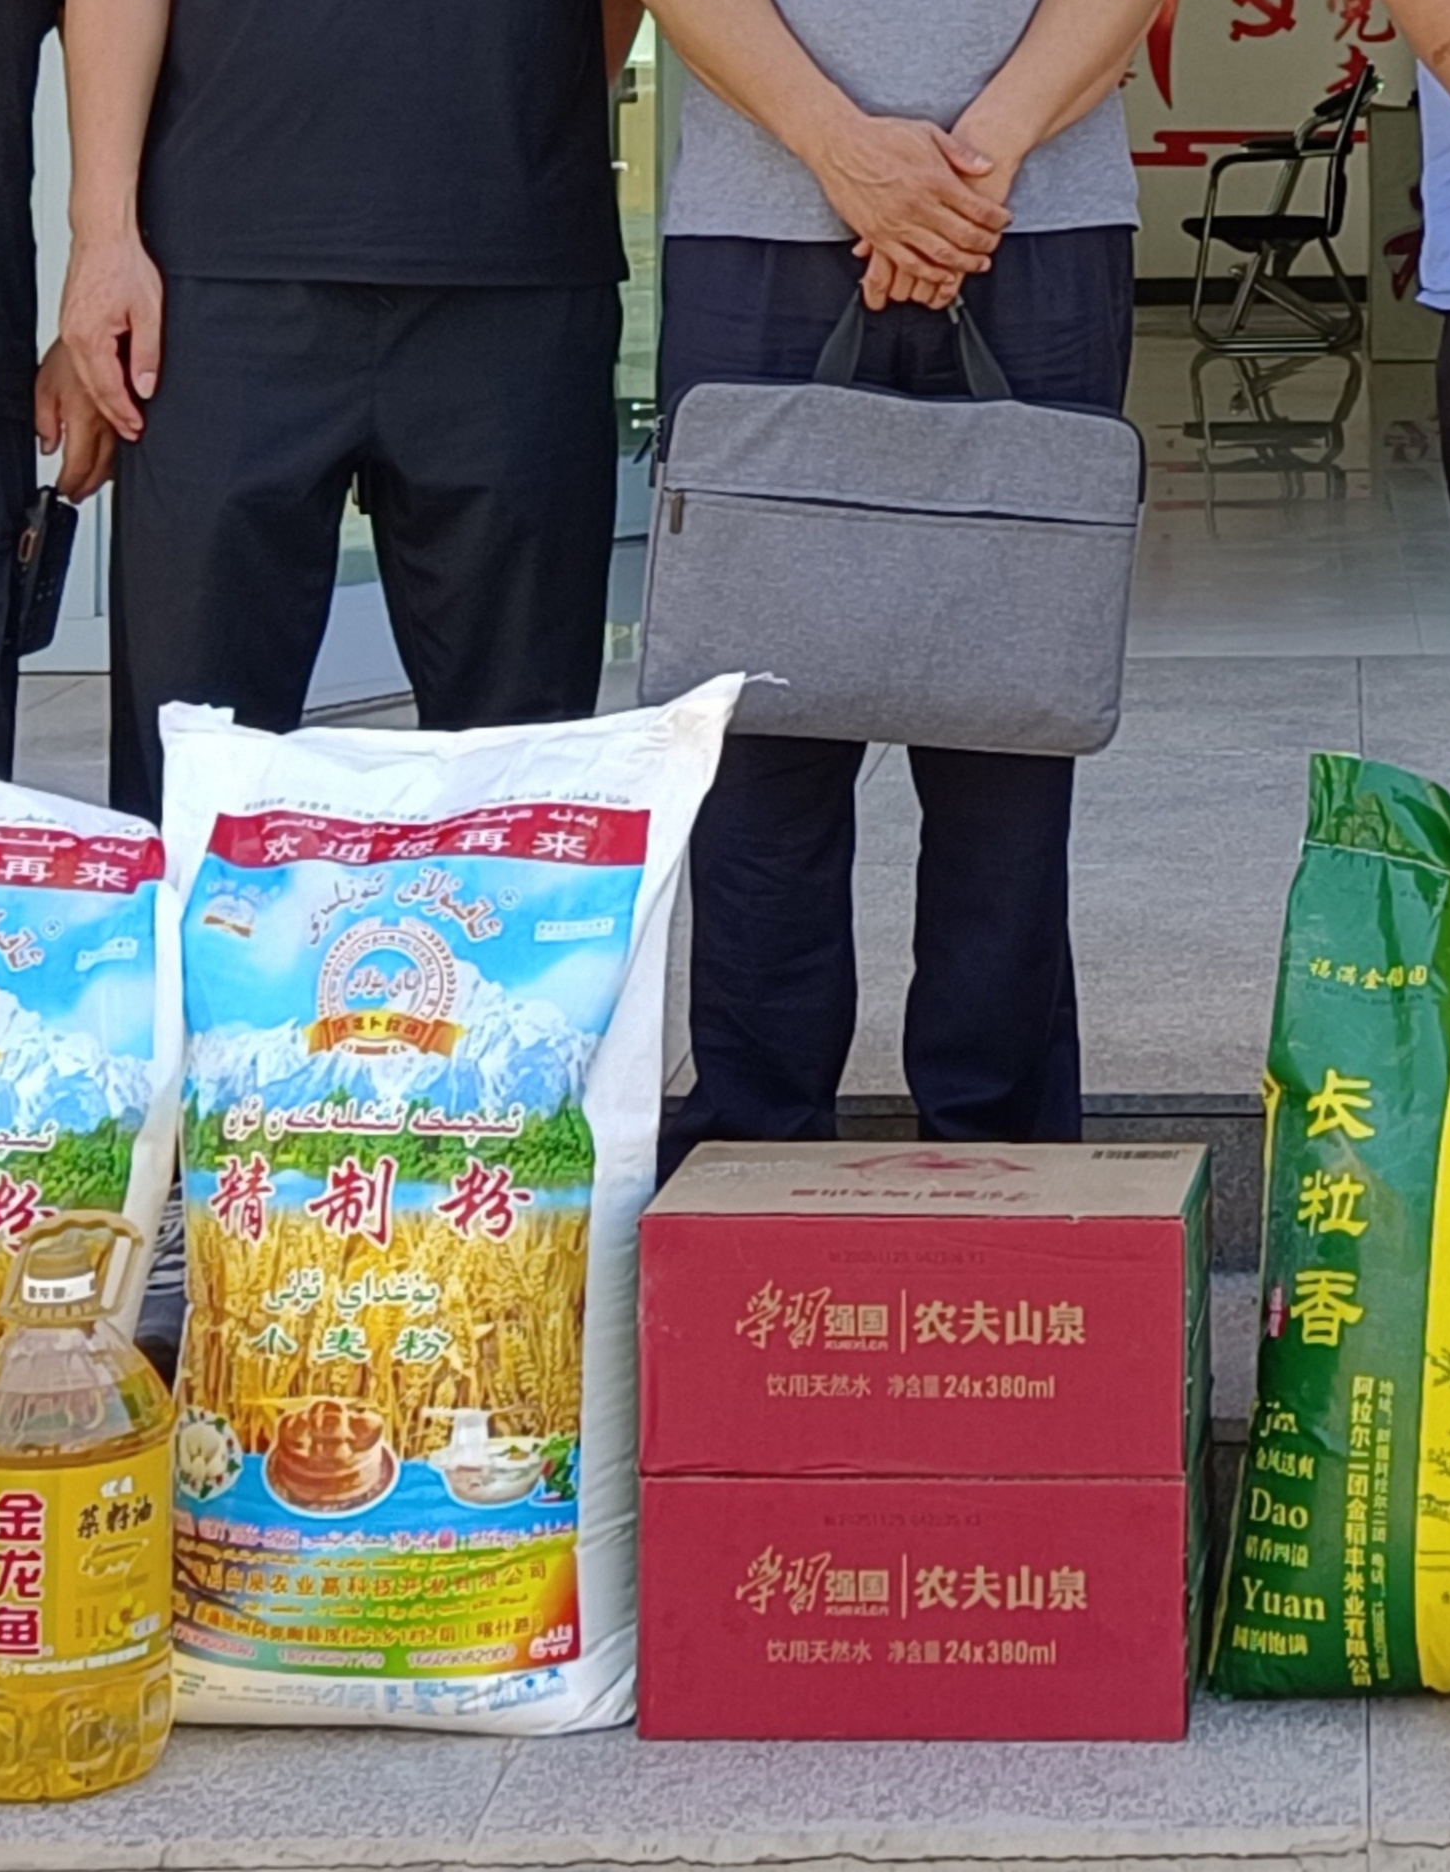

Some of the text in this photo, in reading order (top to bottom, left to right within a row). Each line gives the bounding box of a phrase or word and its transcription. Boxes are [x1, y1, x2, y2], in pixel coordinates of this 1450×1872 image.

[262, 827, 589, 864] 欢迎您再来
[210, 1159, 531, 1245] 精制粉
[1290, 1070, 1375, 1347] 长粒香
[252, 1328, 448, 1362] 小麦粉
[913, 1300, 1087, 1346] 农夫山泉
[766, 1374, 1055, 1398] 饮用天然水 净含量 24x380ml
[1249, 1487, 1308, 1530] Dao
[914, 1565, 1088, 1611] 农夫山泉
[1242, 1576, 1326, 1621] Yuan
[766, 1639, 1057, 1664] 饮用天然水 净含量 24x380ml
